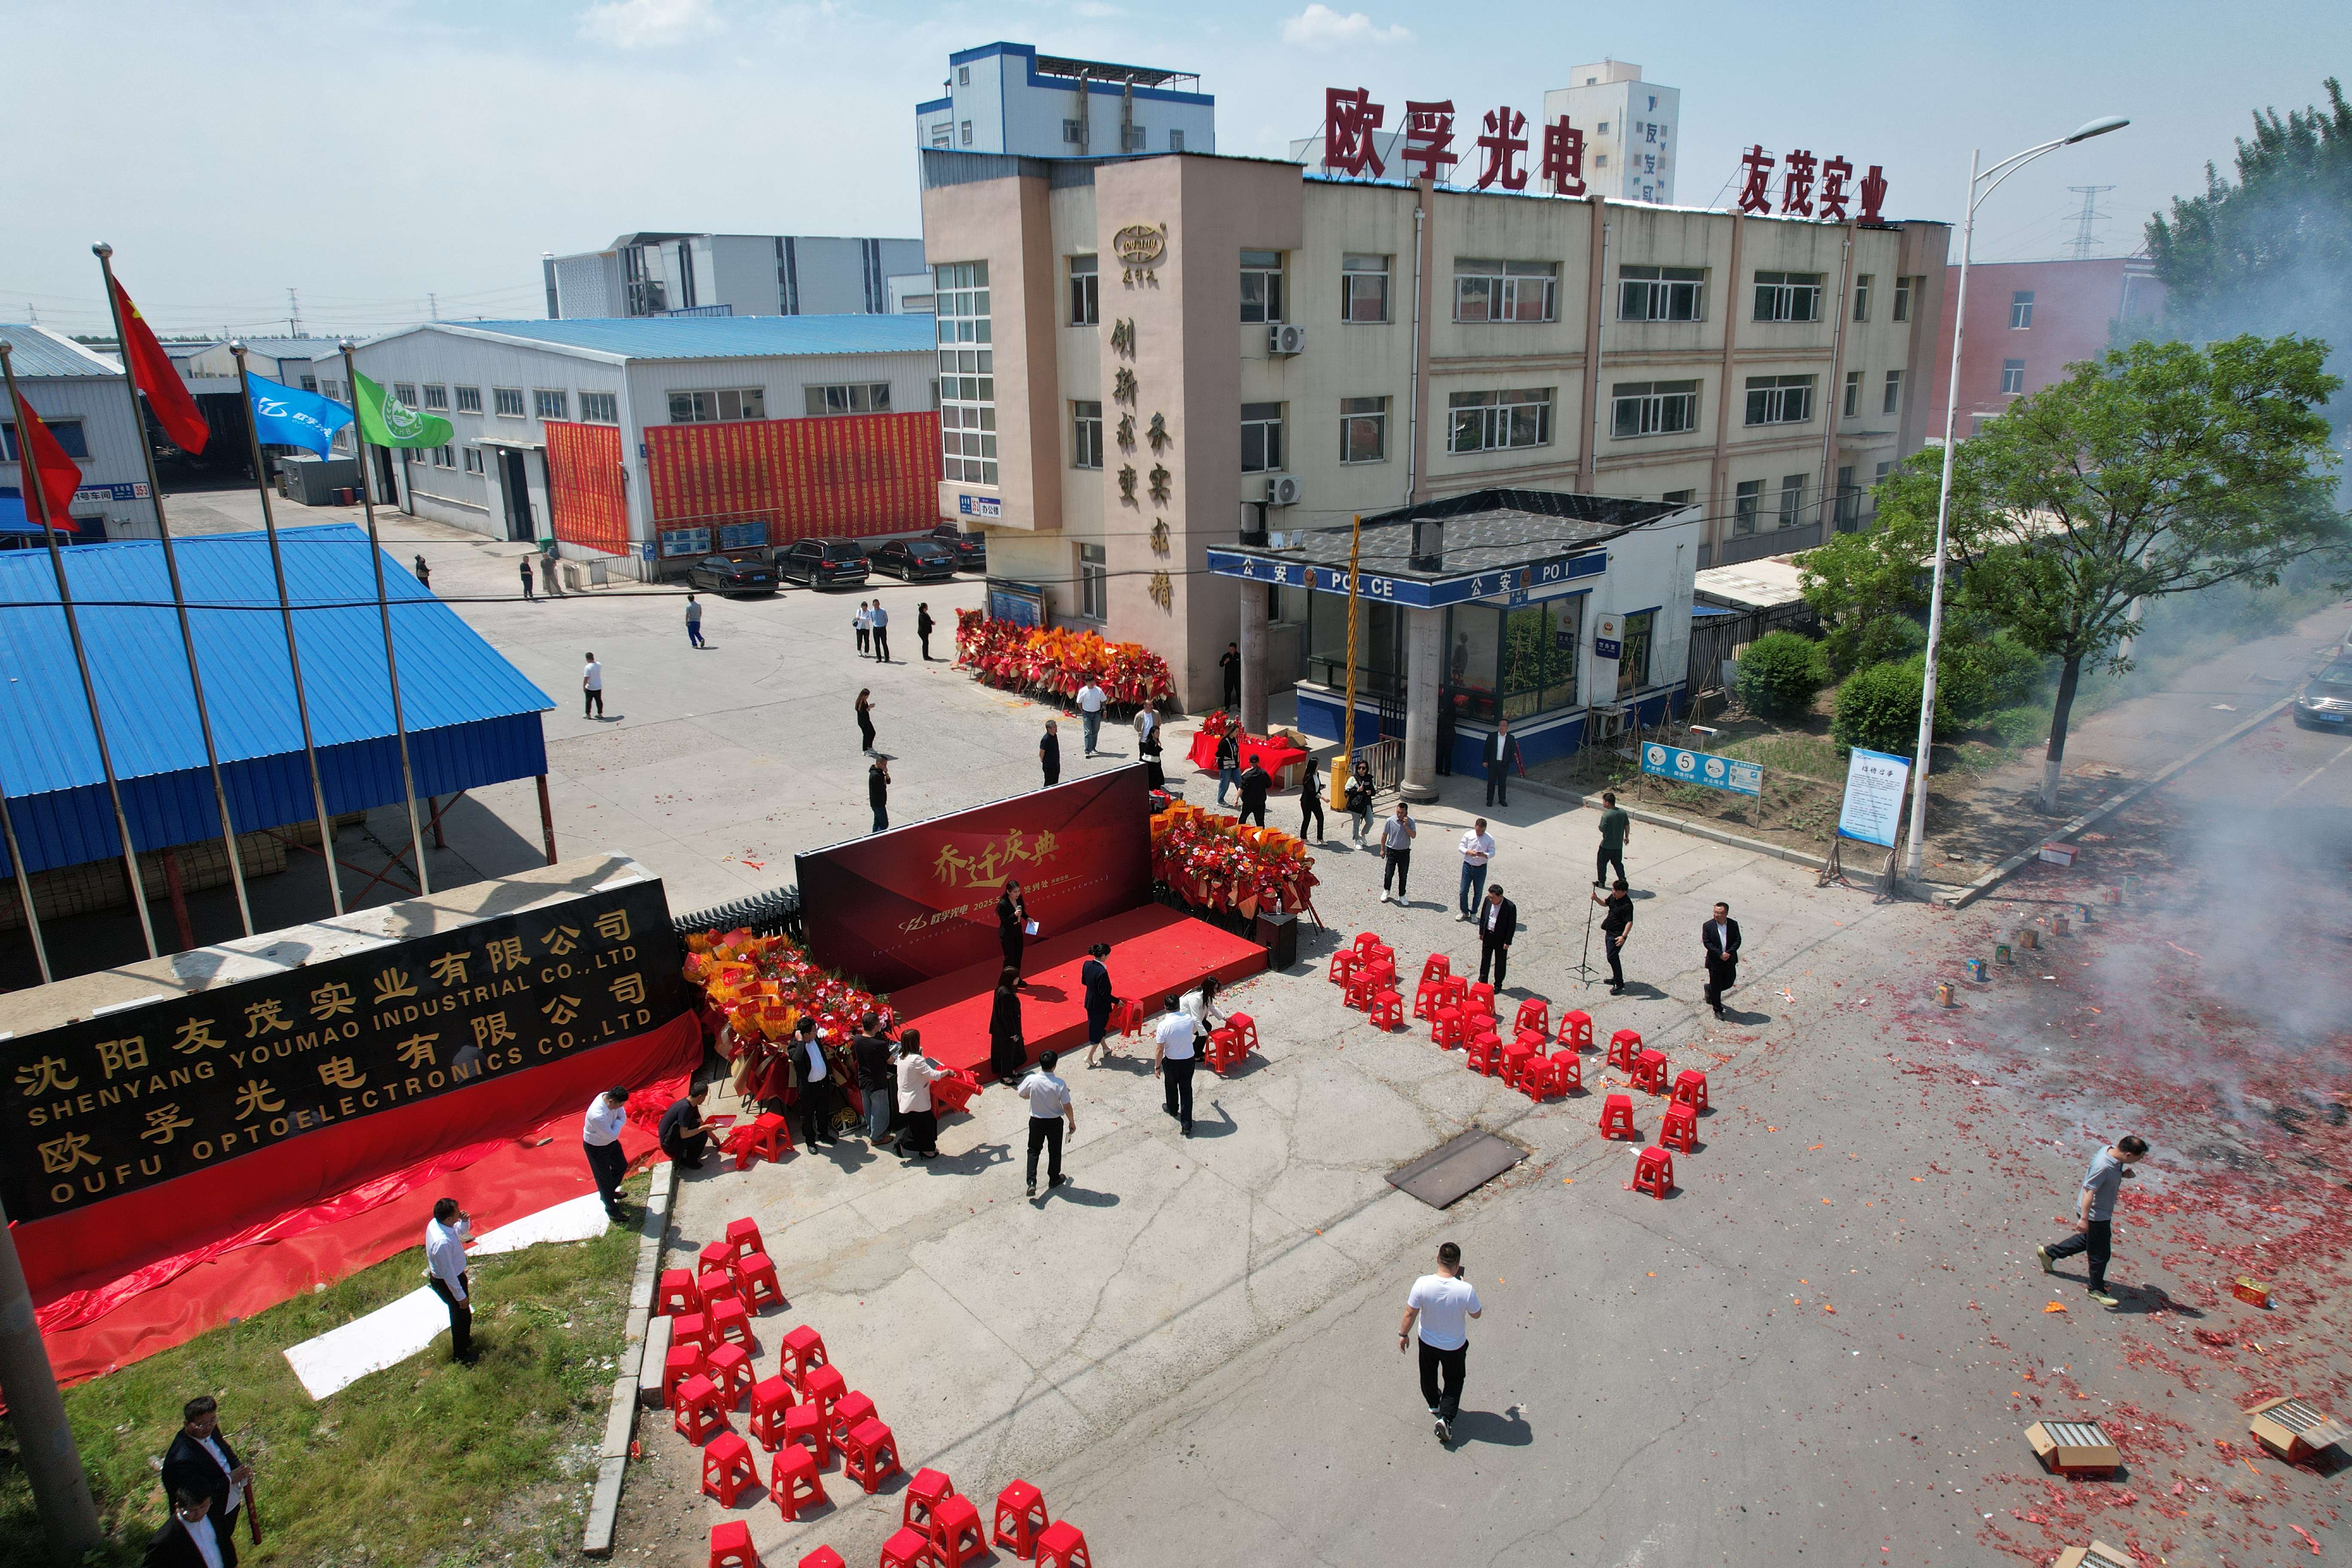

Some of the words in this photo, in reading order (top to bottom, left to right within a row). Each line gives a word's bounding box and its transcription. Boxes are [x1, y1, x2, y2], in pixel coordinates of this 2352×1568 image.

[1326, 87, 1588, 196] 欧孚光电
[1739, 144, 1887, 223] 友茂实业
[393, 427, 411, 435] ZHB
[74, 492, 111, 501] 1号车间
[135, 485, 148, 495] 35-3
[983, 504, 999, 516] 办公楼
[1144, 411, 1173, 610] 务实求精
[646, 544, 652, 553] P
[1243, 558, 1288, 582] 公安
[1471, 573, 1511, 597] 公安
[1681, 756, 1690, 769] 5
[931, 828, 1061, 888] 乔迁庆典
[930, 904, 969, 925] 欧孚光电
[1023, 879, 1049, 894] 签到处
[15, 908, 631, 1099] 沈阳友茂实业有限公司
[28, 1060, 215, 1129] SHENYANG
[228, 1020, 360, 1069] YOUMAO
[372, 974, 532, 1031] INDUSTRIAL
[38, 971, 646, 1176] 欧孚光电有限公司
[51, 1153, 164, 1204] OUFU
[192, 1045, 523, 1160] OPTOELECTRONICS
